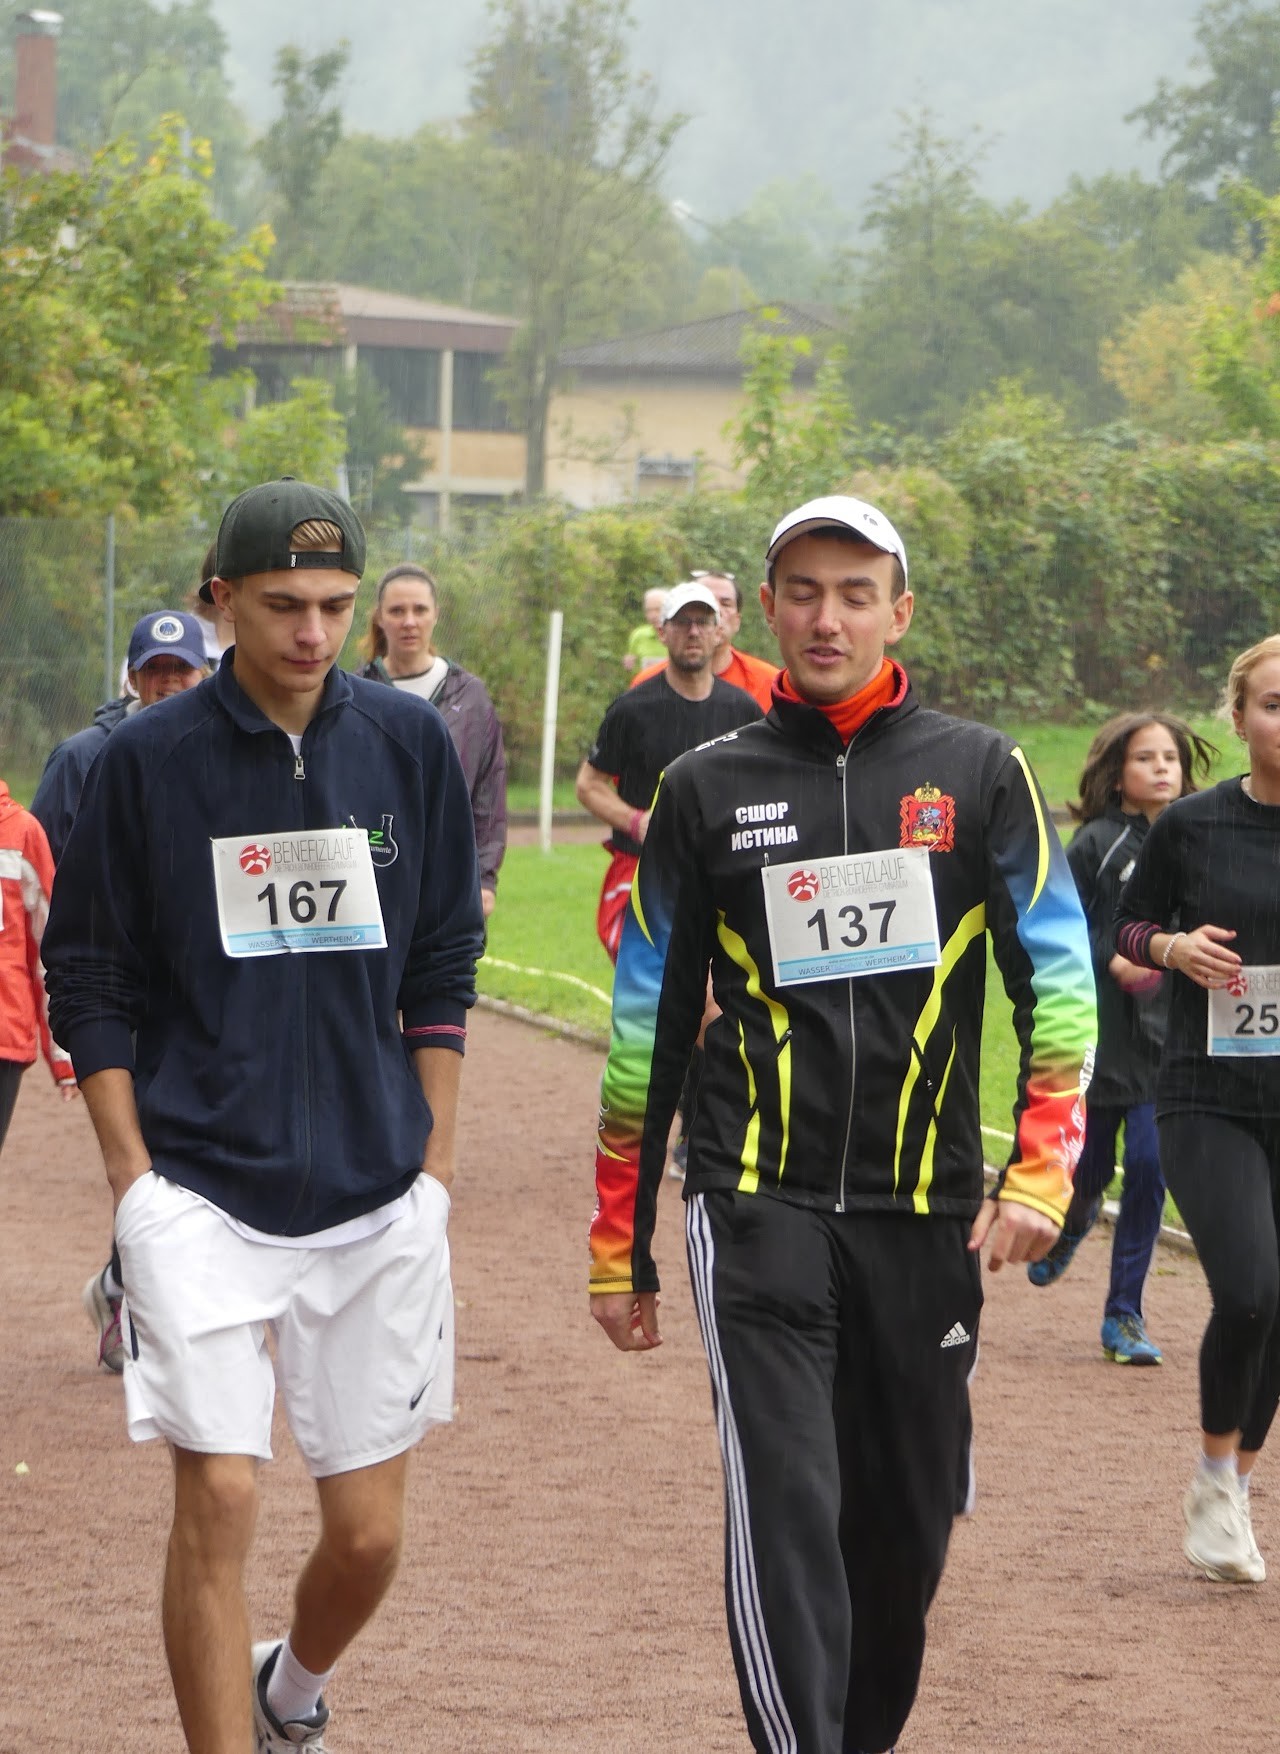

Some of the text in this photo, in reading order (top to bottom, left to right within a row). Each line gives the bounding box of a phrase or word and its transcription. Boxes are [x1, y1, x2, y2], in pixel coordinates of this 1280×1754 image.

[735, 801, 789, 825] СШОР
[273, 838, 354, 863] BENEFIZLAUF
[731, 825, 799, 852] ИСТИНА
[820, 856, 905, 890] BENEFIZLAUF
[257, 879, 347, 926] 167
[807, 900, 897, 951] 137
[311, 935, 353, 944] WERTHEIM
[864, 954, 907, 967] WERTHEIM
[940, 1334, 971, 1349] adidas
